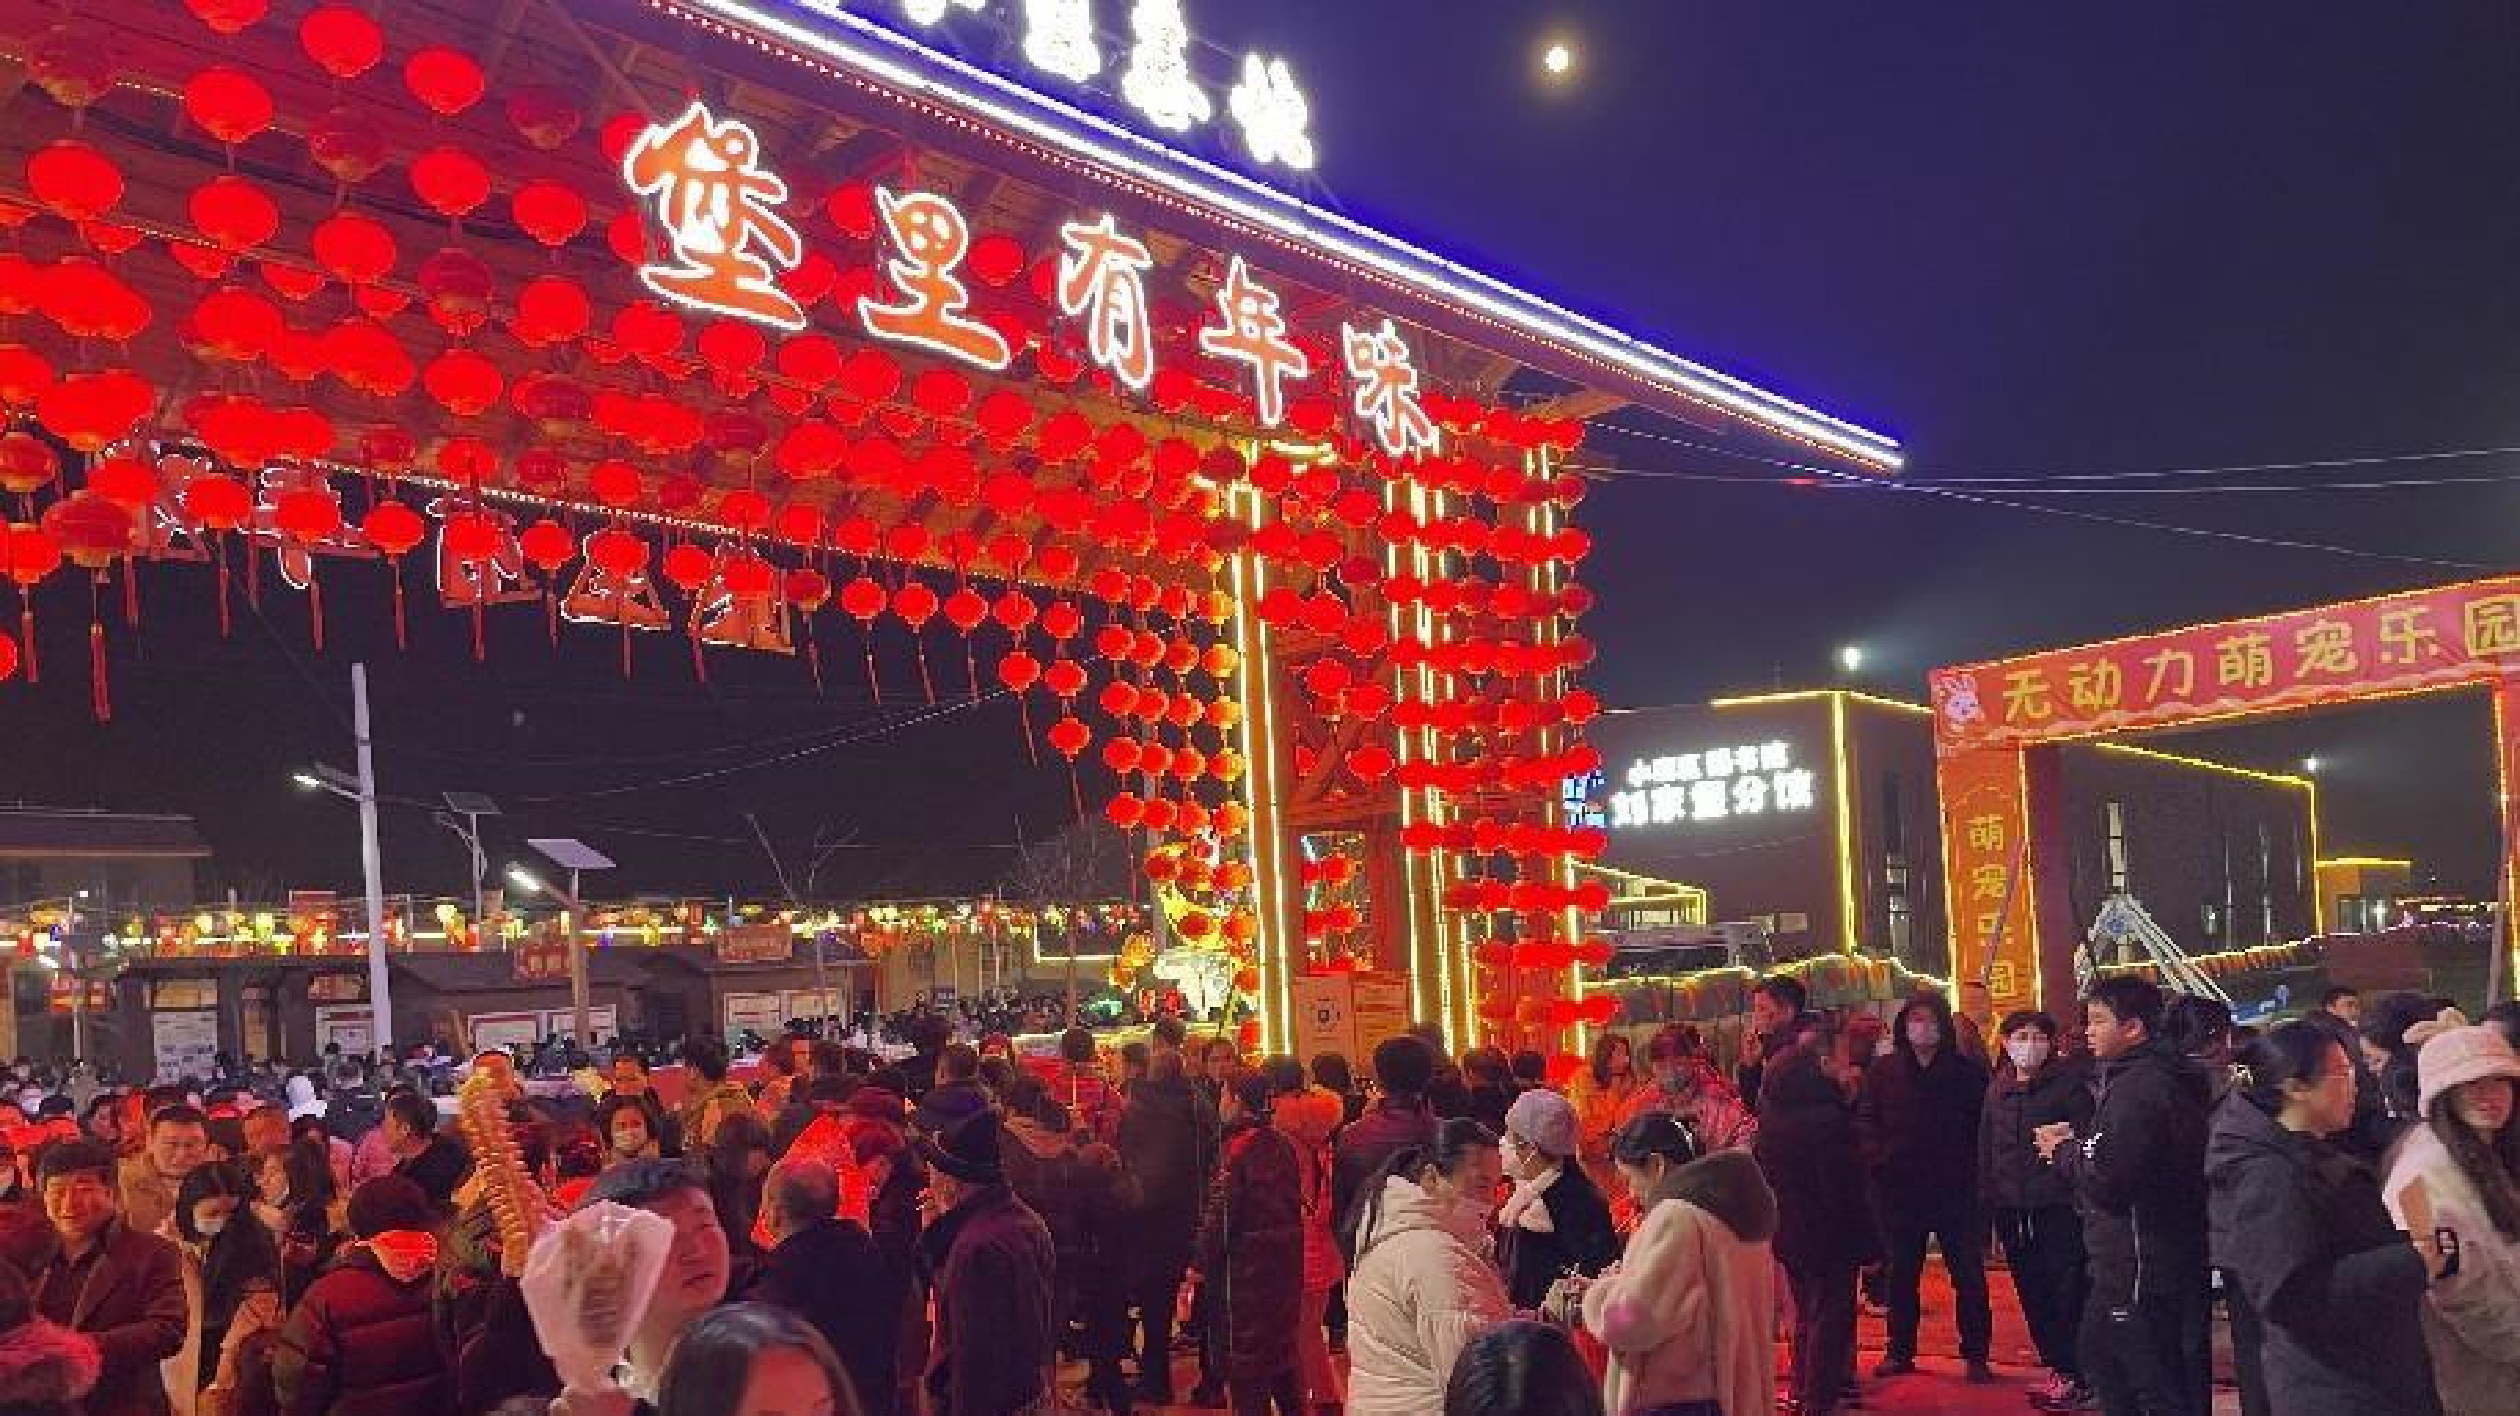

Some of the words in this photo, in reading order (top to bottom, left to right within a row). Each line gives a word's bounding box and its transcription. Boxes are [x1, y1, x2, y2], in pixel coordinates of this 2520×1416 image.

[623, 102, 1438, 457] 堡里有年味
[2001, 594, 2520, 722] 无动力萌宠乐园
